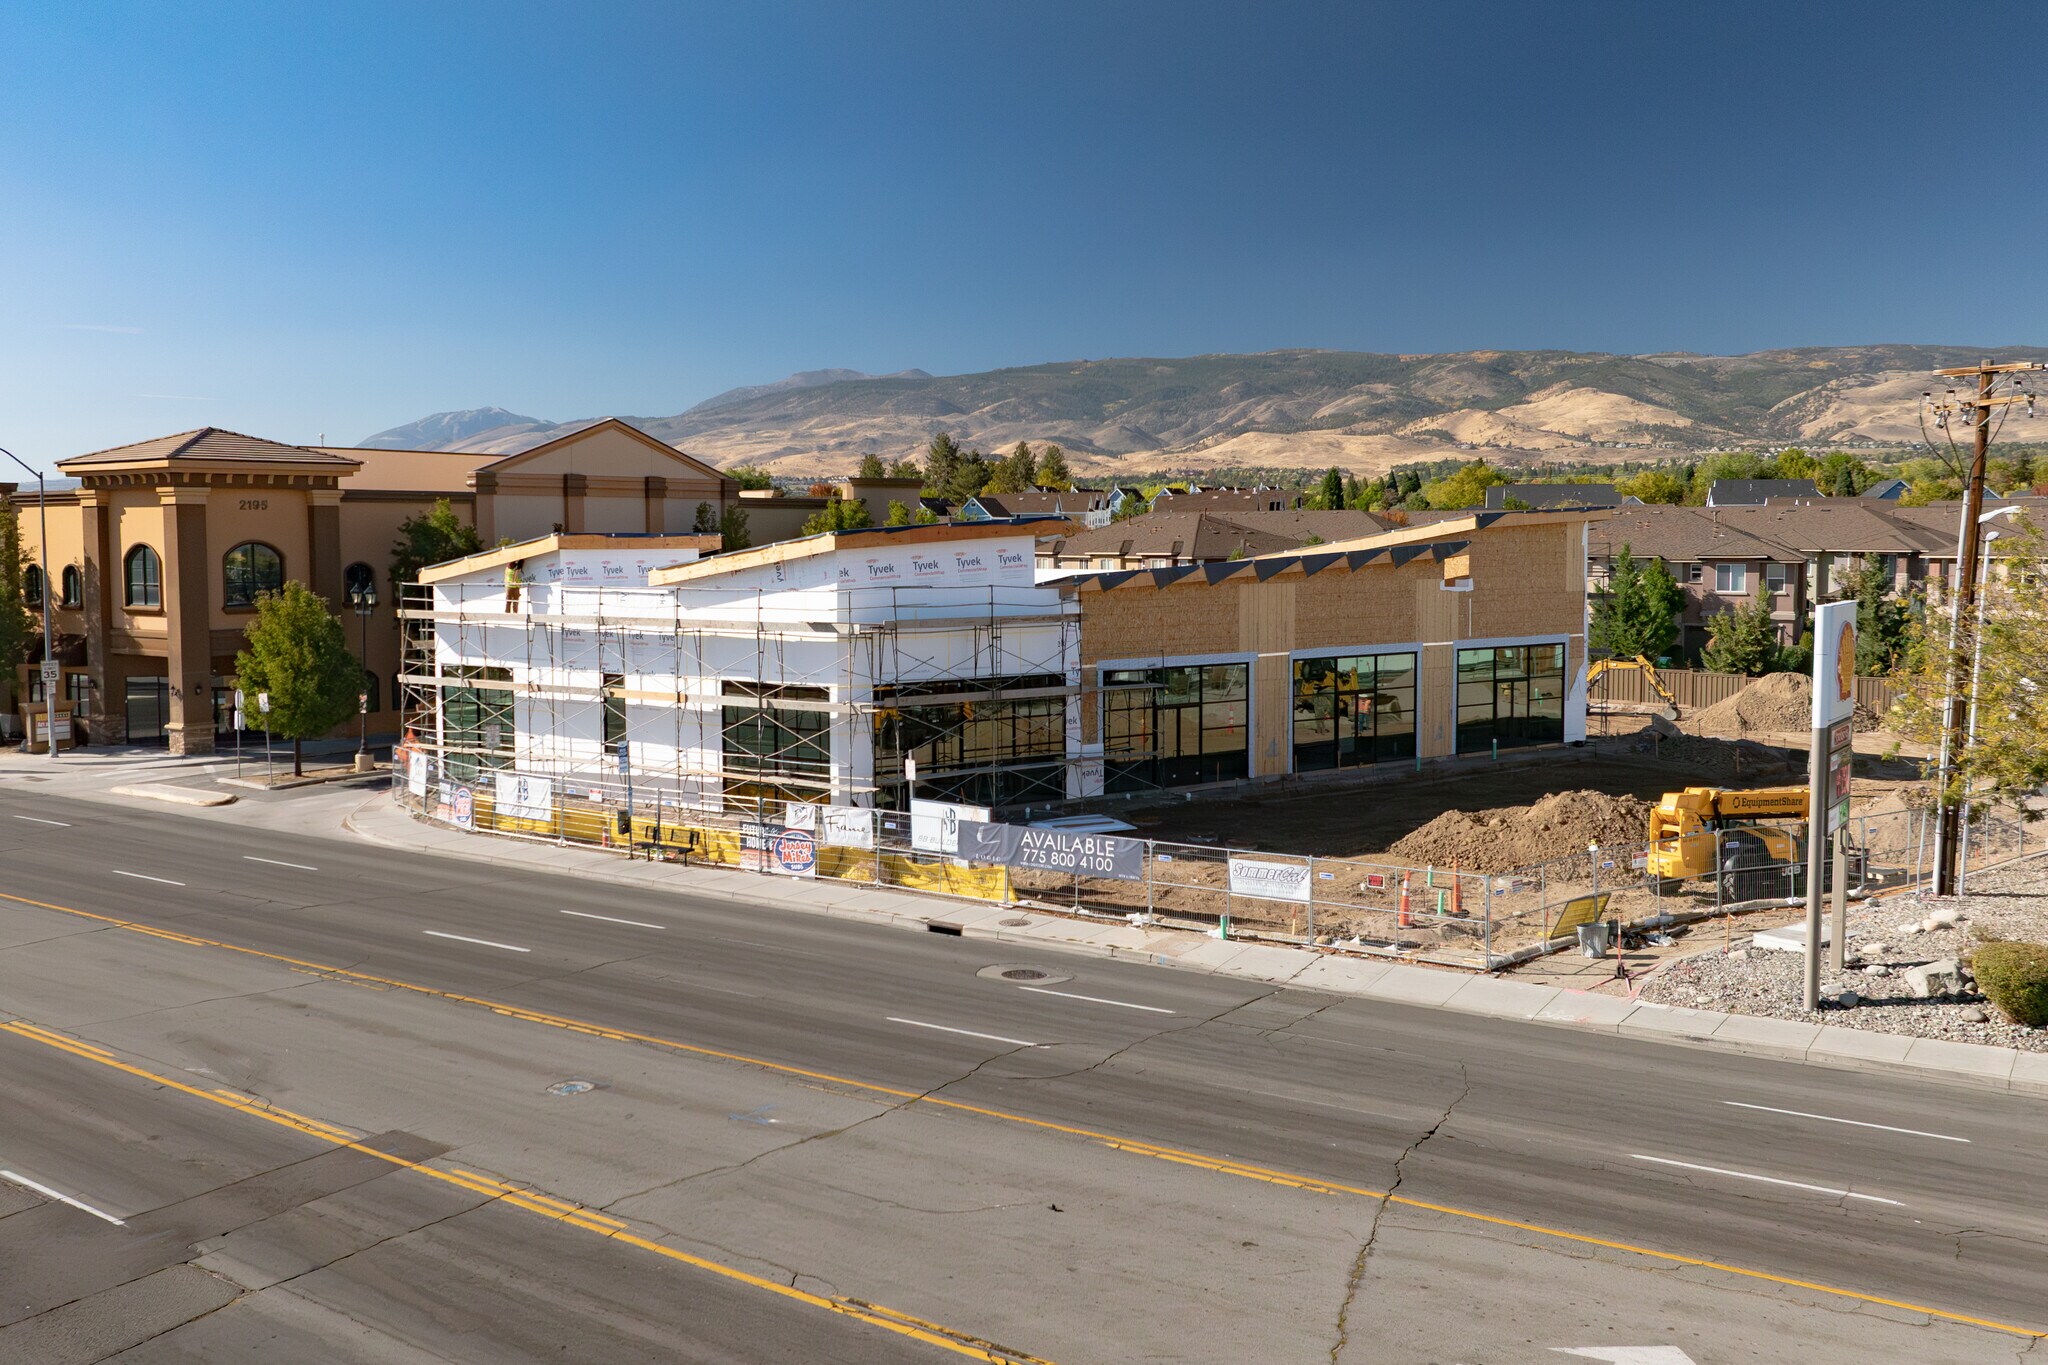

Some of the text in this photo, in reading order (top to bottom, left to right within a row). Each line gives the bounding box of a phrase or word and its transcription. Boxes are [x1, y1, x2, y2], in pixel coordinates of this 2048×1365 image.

[239, 500, 268, 511] 2195
[956, 557, 981, 569] Tyvek
[998, 554, 1022, 565] Tyvek
[566, 566, 588, 577] Tyvek
[602, 566, 624, 576] Tyvek
[868, 563, 895, 576] Tyvek
[913, 560, 939, 572] Tyvek
[43, 671, 57, 679] 35
[1742, 797, 1803, 808] EquipmentShare
[780, 838, 812, 853] Jersey
[1021, 831, 1115, 858] AVAILABLE
[782, 850, 813, 863] Mike's
[1023, 848, 1047, 863] 775
[1050, 852, 1075, 867] 800
[1080, 856, 1113, 872] 4100
